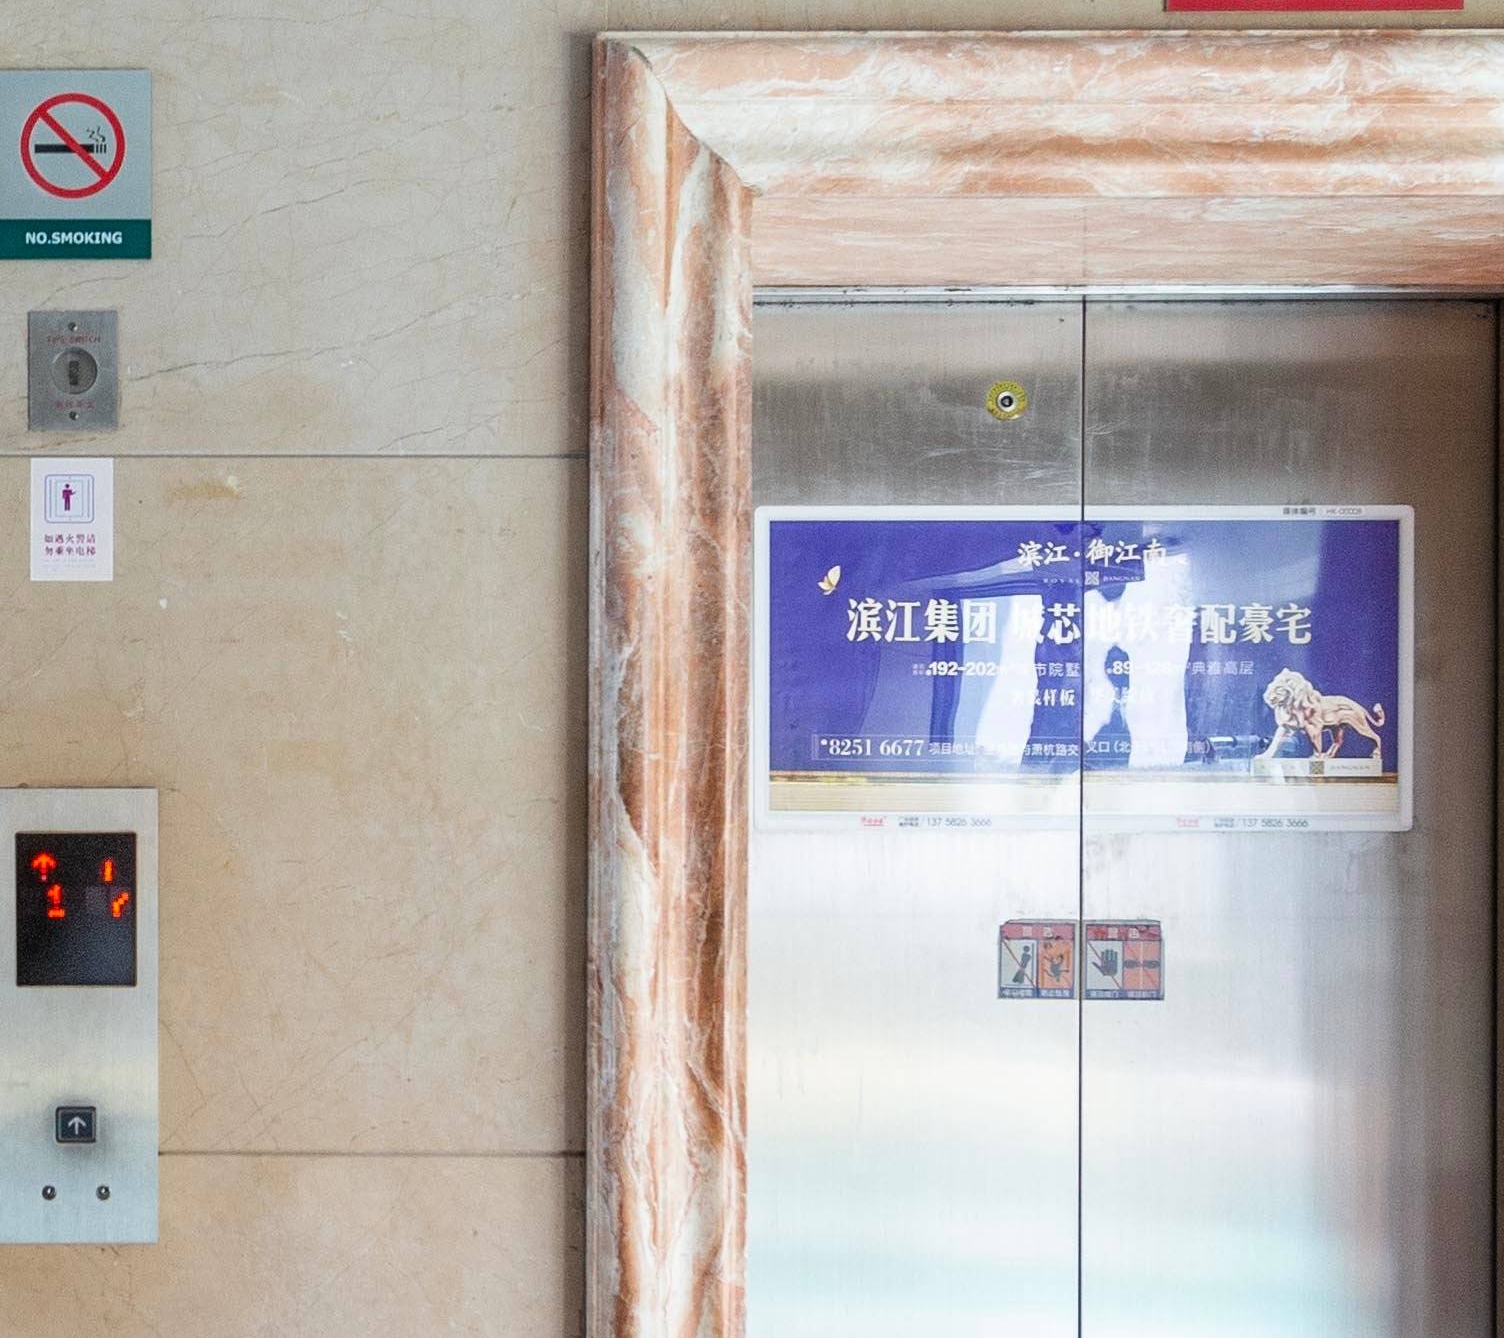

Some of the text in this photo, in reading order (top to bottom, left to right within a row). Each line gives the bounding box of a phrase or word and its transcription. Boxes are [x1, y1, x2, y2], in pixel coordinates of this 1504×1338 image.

[25, 231, 123, 245] NO.SMOKING
[846, 598, 997, 644] 滨江集团
[879, 738, 924, 757] 6677
